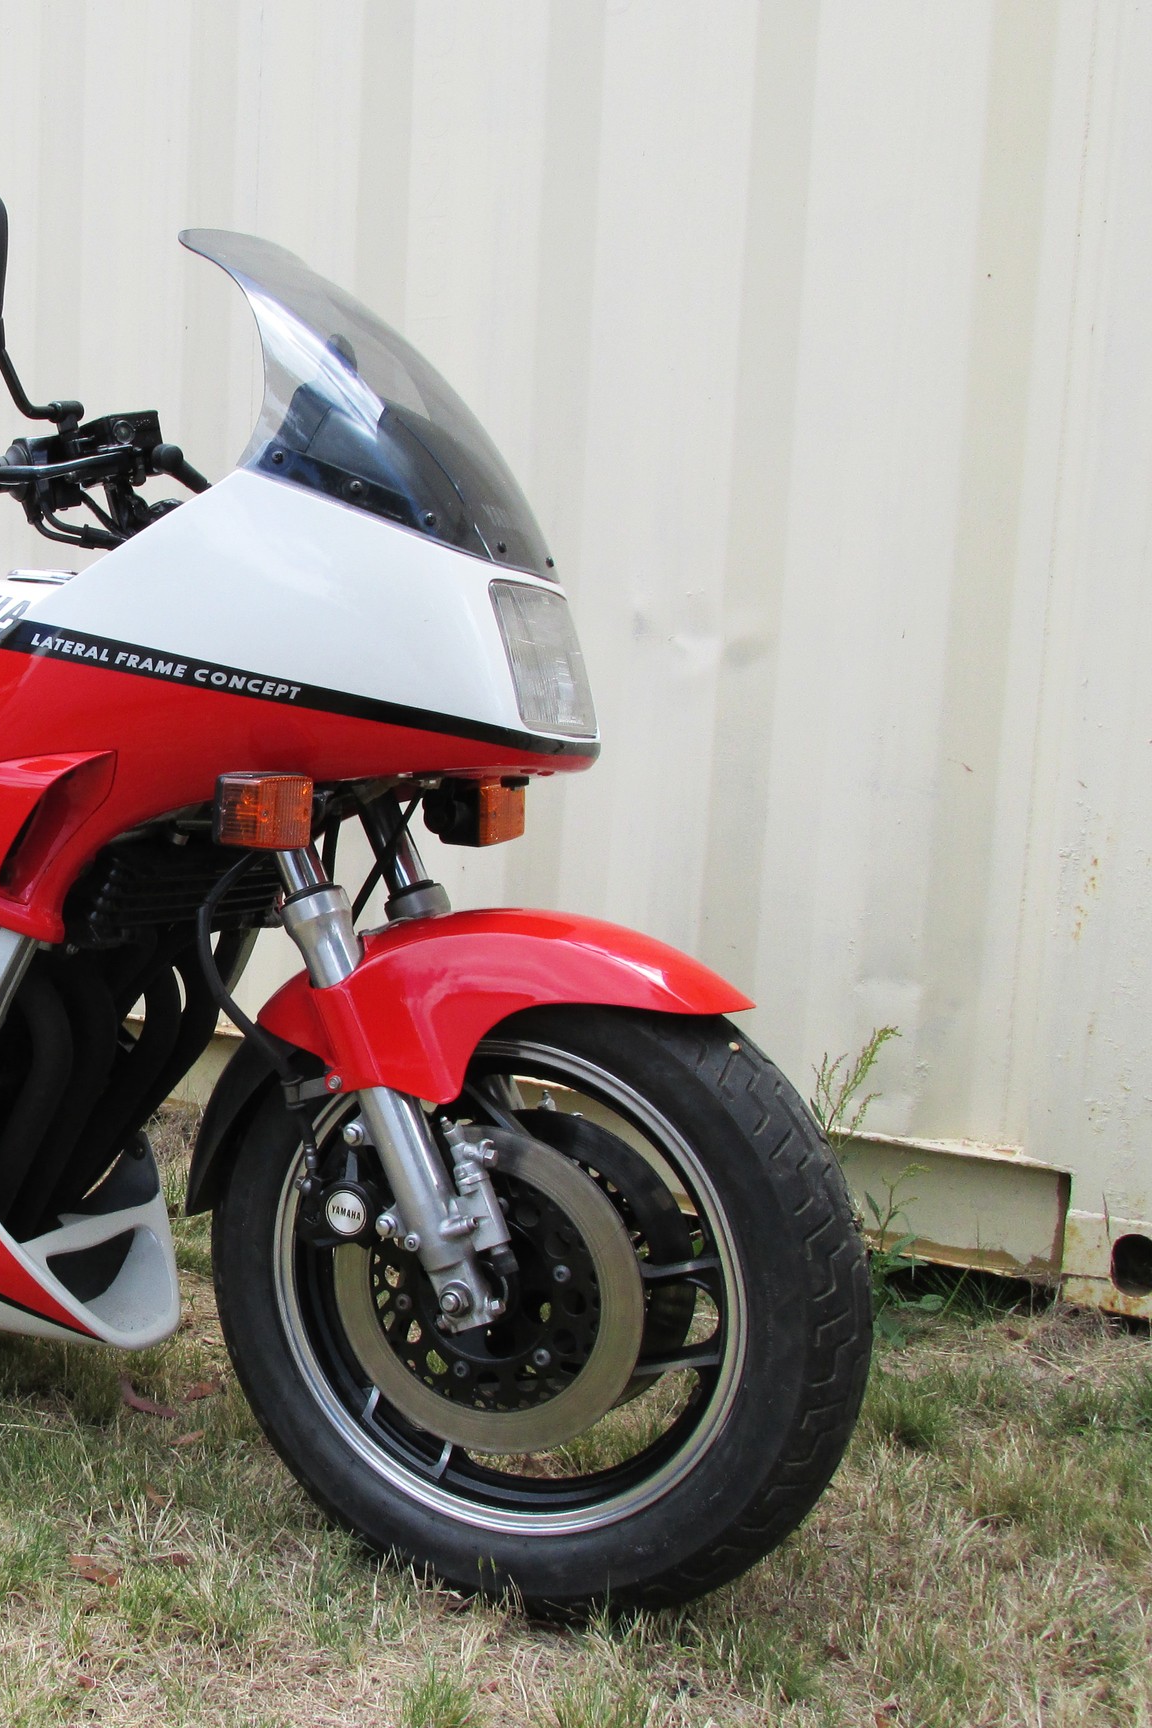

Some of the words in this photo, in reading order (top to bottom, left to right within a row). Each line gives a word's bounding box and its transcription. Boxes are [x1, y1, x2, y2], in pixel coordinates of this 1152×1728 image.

[30, 633, 109, 662] LATERAL
[114, 651, 188, 678] FRAME
[194, 668, 301, 700] CONCEPT
[331, 1204, 361, 1221] YAMAHA
